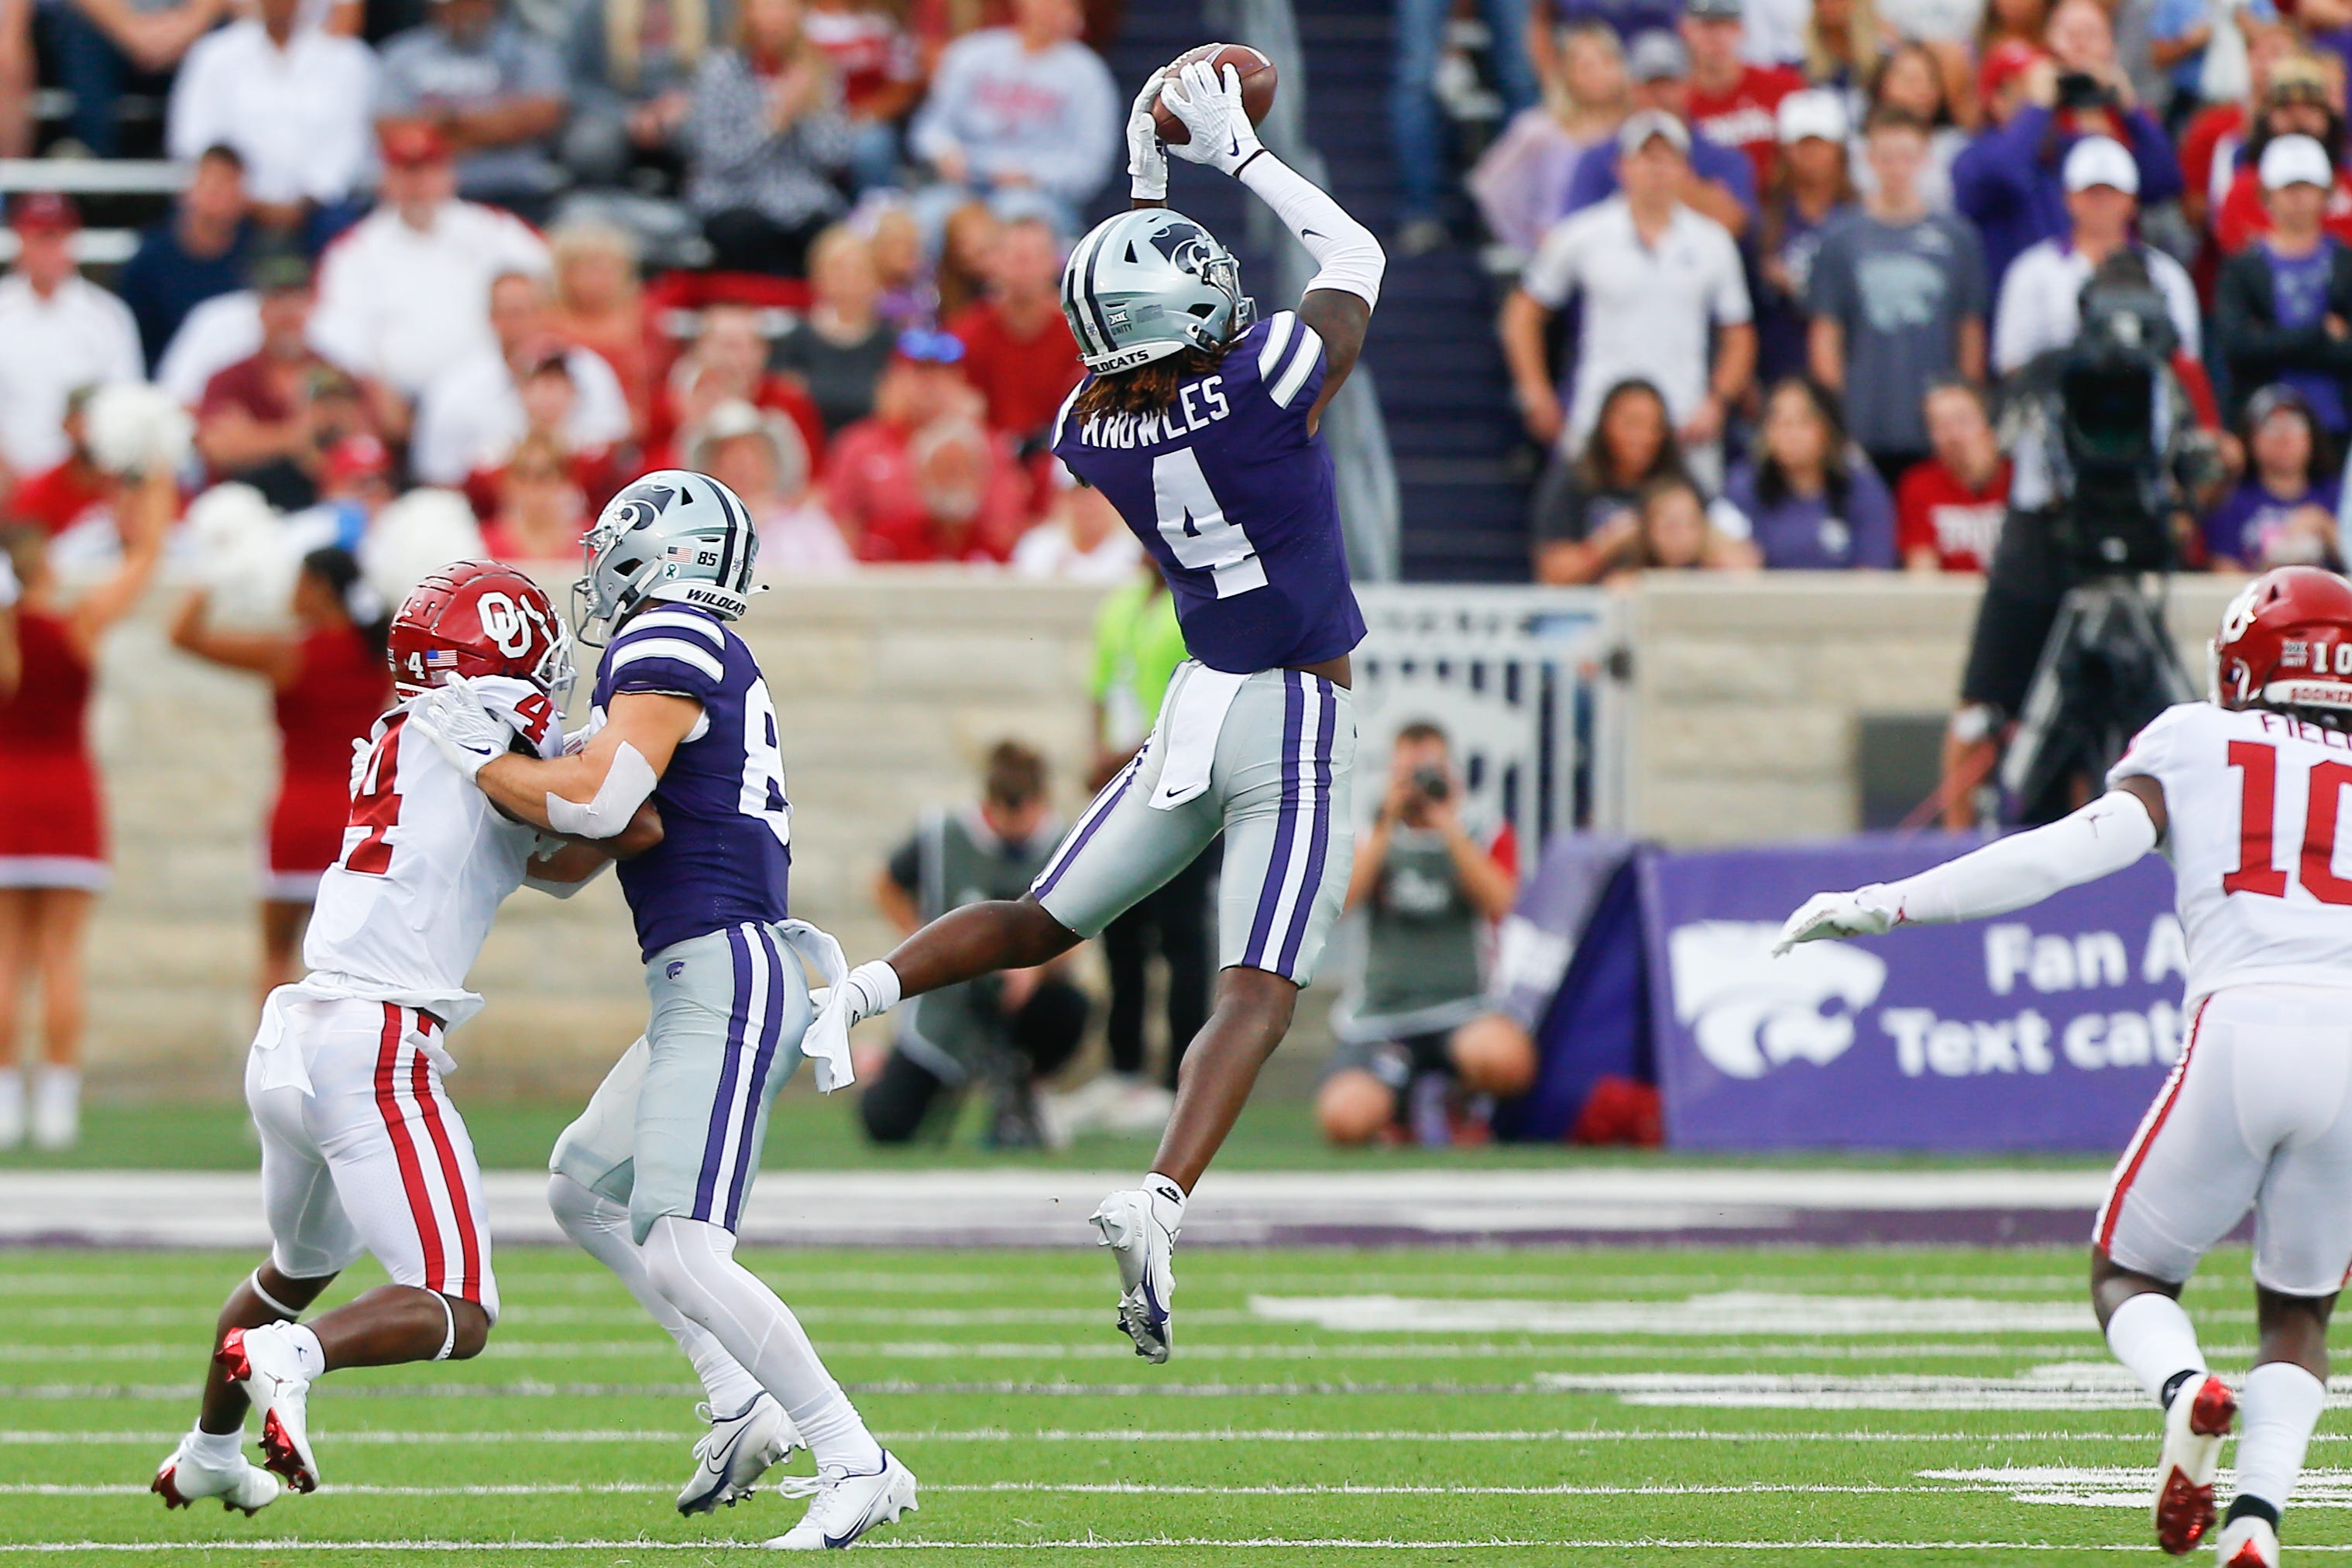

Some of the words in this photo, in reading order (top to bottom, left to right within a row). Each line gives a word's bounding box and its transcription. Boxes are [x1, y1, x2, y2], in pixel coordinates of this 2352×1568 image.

[1111, 323, 1132, 336] UNITY
[1087, 349, 1149, 373] LDCATS
[1081, 375, 1230, 449] KNOWLES
[1152, 446, 1269, 599] 4
[697, 551, 719, 566] 85
[476, 592, 533, 658] OU
[407, 651, 426, 680] 4
[2312, 640, 2352, 674] 10
[513, 692, 553, 745] 4
[2261, 712, 2352, 750] FIEL
[345, 711, 403, 875] 4
[2223, 739, 2352, 905] 10
[1984, 922, 2129, 996] Fan
[1878, 1007, 2054, 1077] Text
[2063, 999, 2183, 1069] cat
